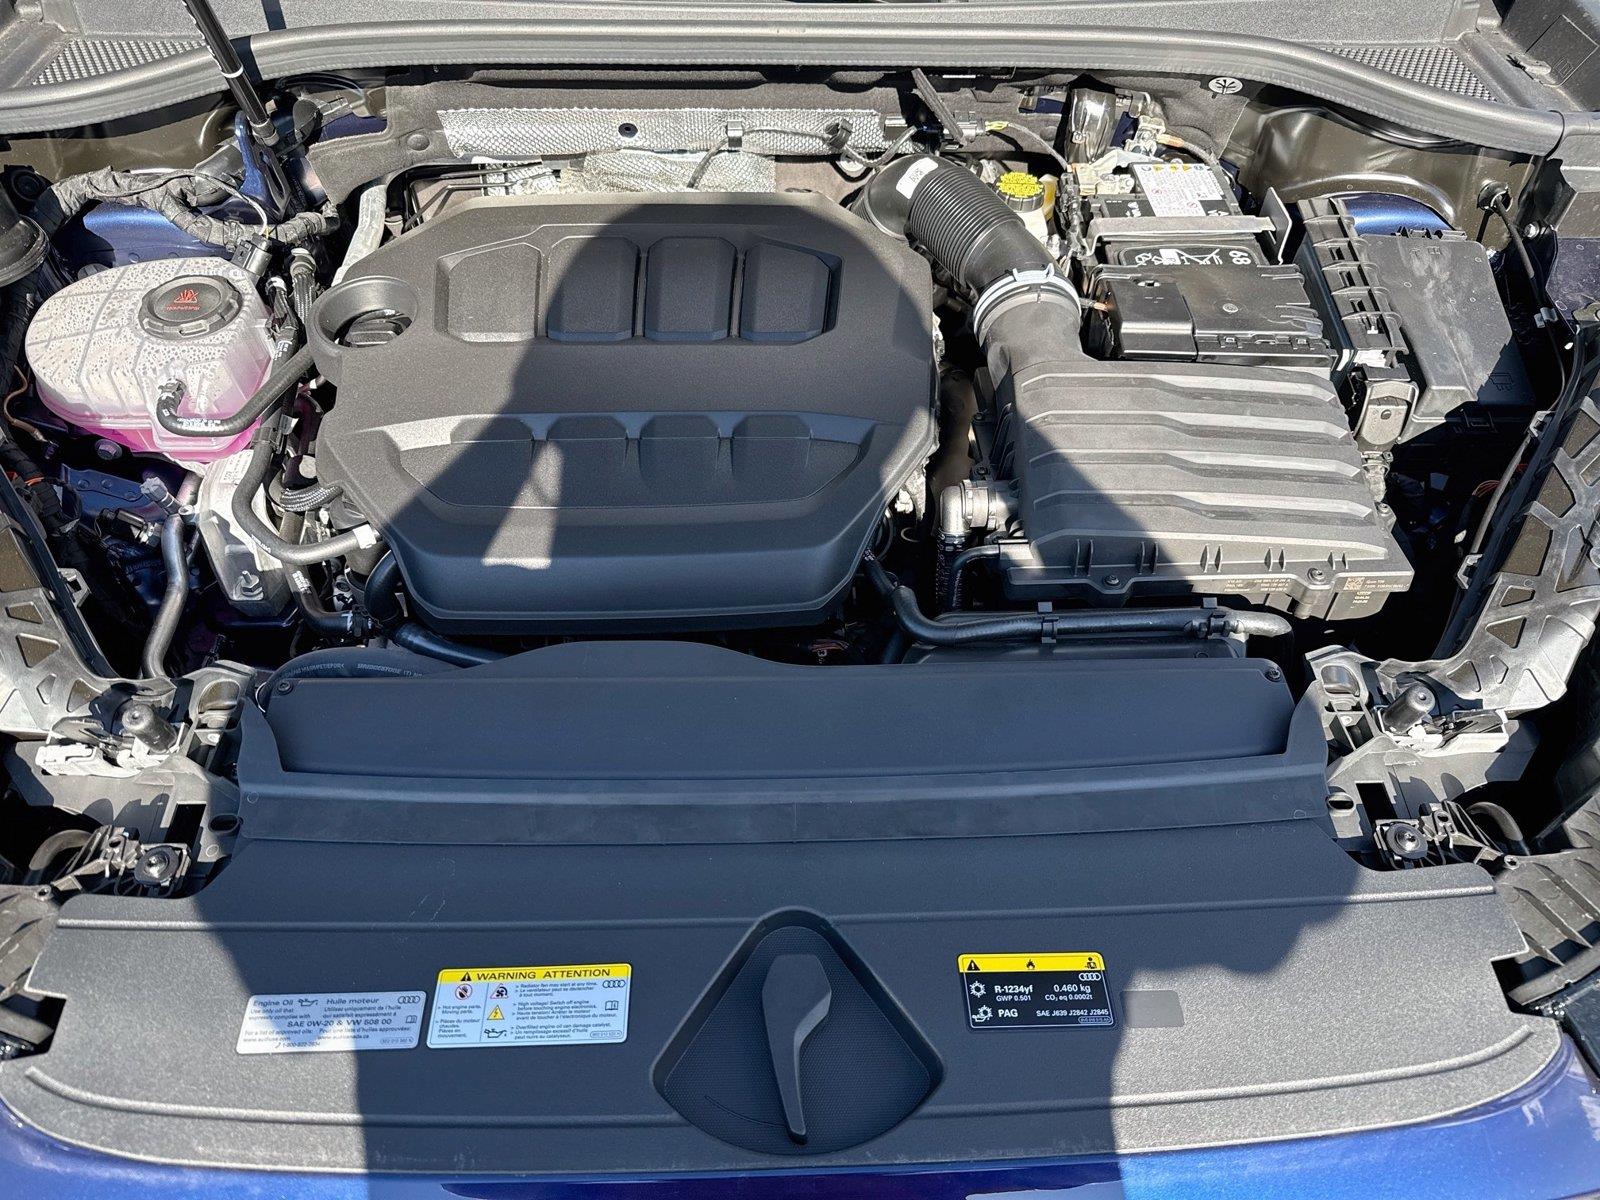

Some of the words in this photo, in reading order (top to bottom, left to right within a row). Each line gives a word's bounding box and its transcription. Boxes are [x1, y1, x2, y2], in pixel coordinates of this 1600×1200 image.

[476, 972, 536, 980] WARNING
[542, 968, 611, 978] ATTENTION
[994, 985, 1033, 994] R-1234yf
[1080, 984, 1091, 993] kg
